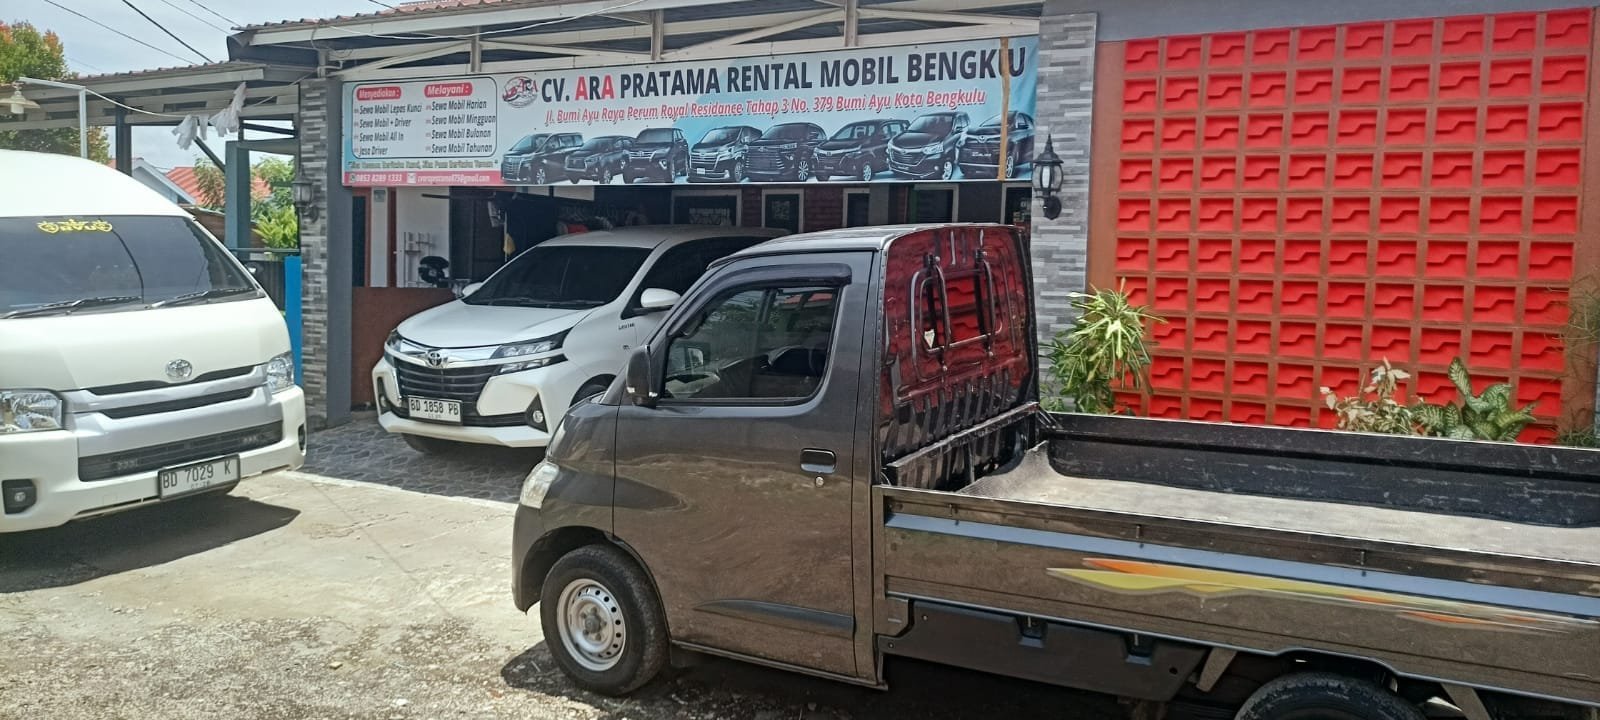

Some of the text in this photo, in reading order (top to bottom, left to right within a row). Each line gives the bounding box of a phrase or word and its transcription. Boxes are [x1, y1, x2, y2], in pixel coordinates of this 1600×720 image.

[541, 78, 570, 102] CV.
[575, 75, 615, 101] ARA
[620, 67, 721, 99] PRATAMA
[727, 61, 813, 93] RENTAL
[820, 55, 899, 87] MOBIL
[427, 84, 464, 97] Melayani
[359, 104, 374, 115] Sewa
[374, 104, 389, 114] Mobil
[431, 99, 488, 111] Sewa Mobil Harian
[557, 109, 580, 122] Bumi
[582, 108, 600, 125] Ayu
[601, 107, 625, 125] Raya
[627, 105, 658, 119] Perum
[661, 103, 689, 121] Royal
[746, 99, 778, 117] Tahap
[781, 98, 789, 114] 3
[791, 97, 810, 112] No.
[813, 95, 834, 112] 379
[836, 95, 866, 112] Bumi
[869, 94, 891, 113] Ayu
[894, 91, 923, 109] Kota
[926, 88, 986, 110] Bengkulu
[359, 118, 374, 129] Sewa
[374, 117, 389, 128] Mobil
[394, 117, 412, 127] Driver
[431, 113, 496, 126] Sewa Mobil Mingguan
[359, 132, 374, 142] Sewa
[374, 131, 389, 141] Mobil
[431, 127, 492, 139] Sewa Mobil Bulanan
[431, 142, 493, 154] Sewa Mobil Tahunan
[411, 399, 459, 415] BD 1858 PB
[162, 472, 178, 489] BD
[184, 463, 214, 483] 7029
[224, 459, 231, 475] K
